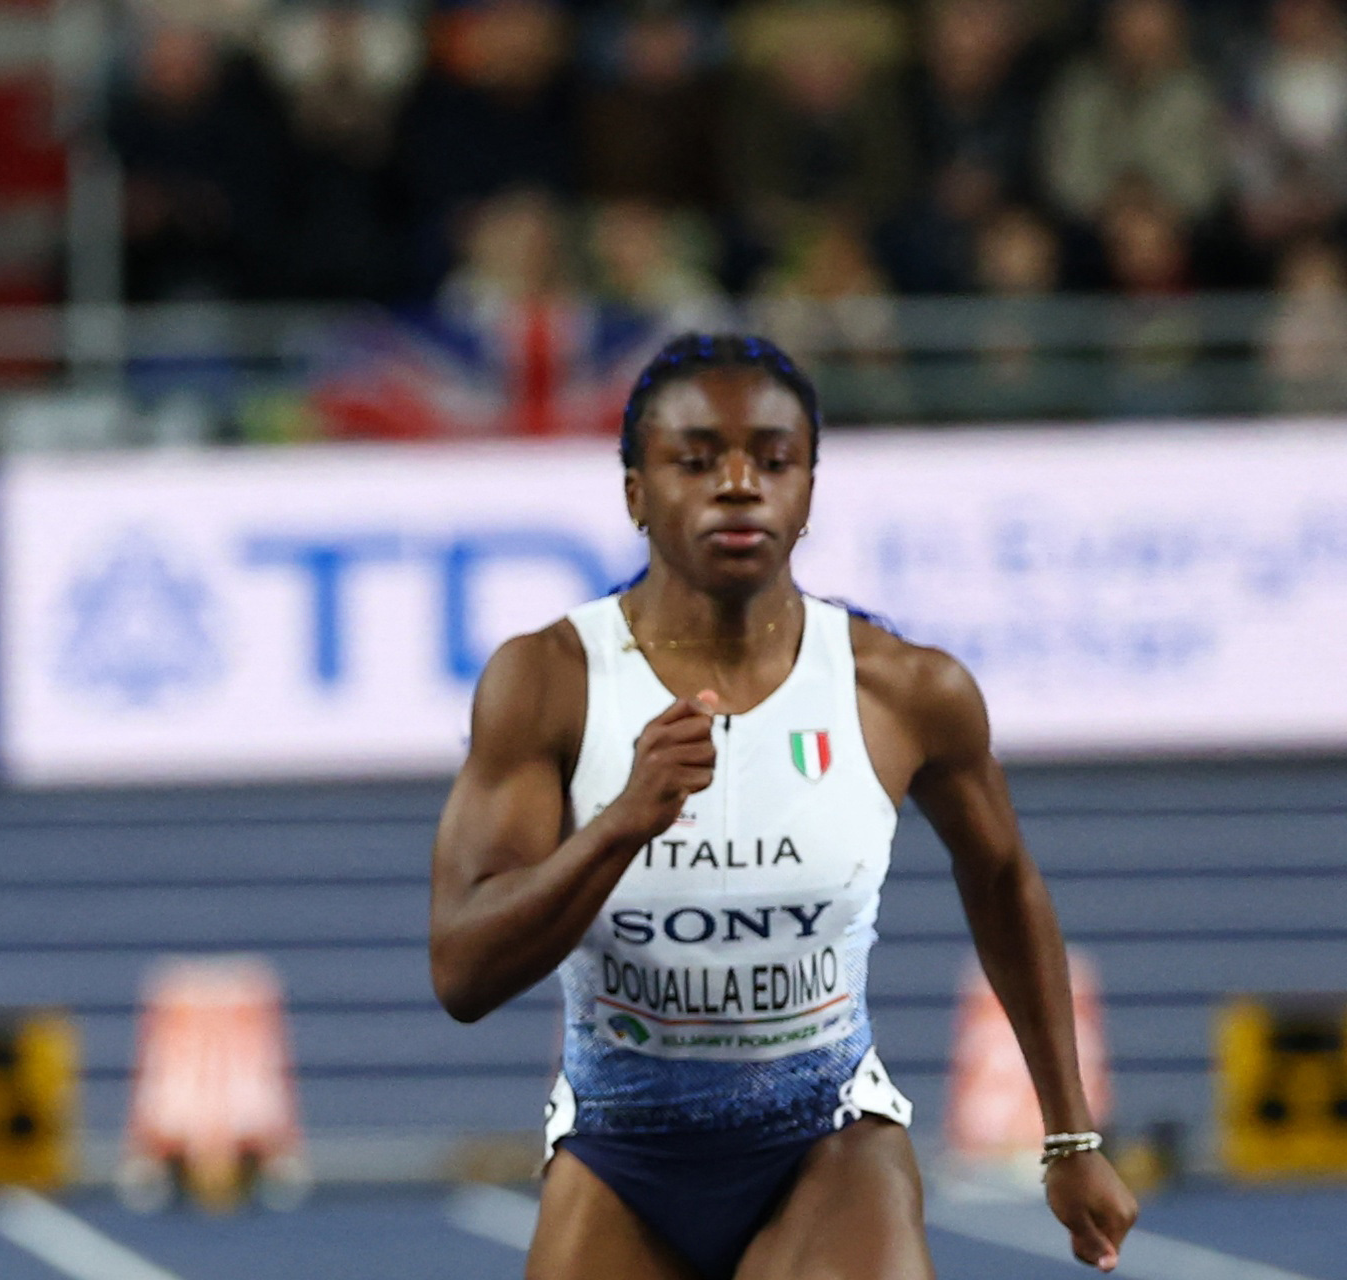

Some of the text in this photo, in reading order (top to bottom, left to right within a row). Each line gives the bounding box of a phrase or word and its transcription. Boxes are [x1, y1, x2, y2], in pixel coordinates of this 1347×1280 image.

[237, 526, 632, 688] TD
[643, 836, 802, 869] ITALIA
[611, 901, 833, 945] SONY
[602, 947, 838, 1014] DOUALLA EDIMO
